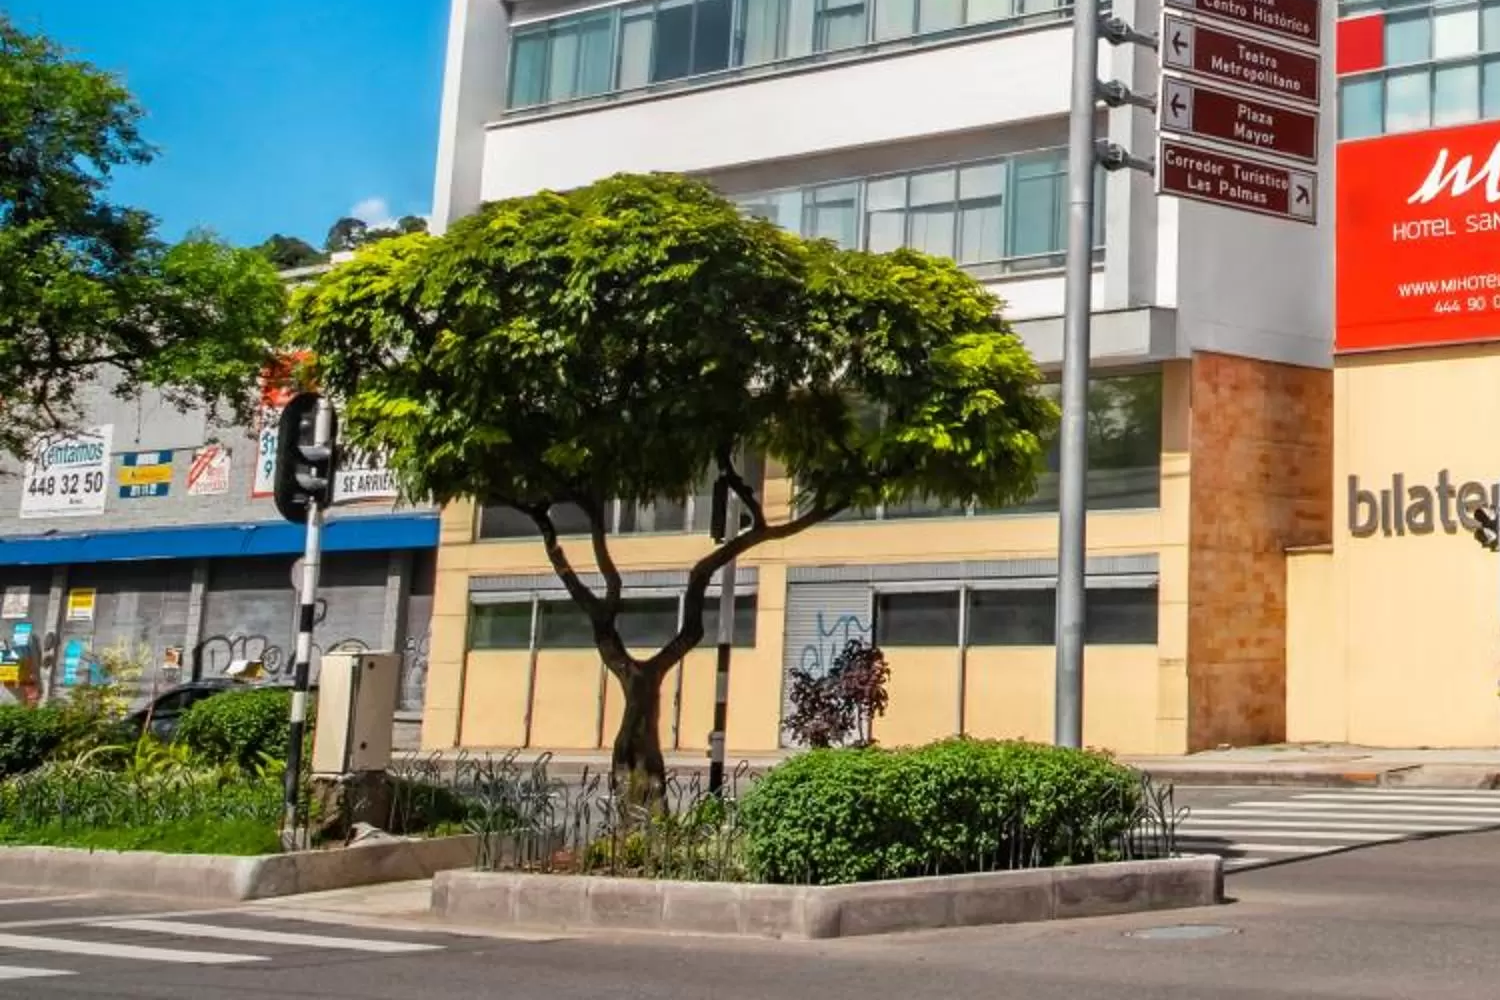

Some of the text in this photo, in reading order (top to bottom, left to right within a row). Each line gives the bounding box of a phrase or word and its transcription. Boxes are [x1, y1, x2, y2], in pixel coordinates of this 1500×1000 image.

[1237, 44, 1278, 69] Teatro
[1211, 55, 1301, 92] Metropolitano
[1237, 103, 1274, 127] Plaza
[1233, 121, 1275, 145] Mayor
[1165, 149, 1224, 177] Corredor
[1187, 172, 1268, 205] Las Palmas
[1433, 298, 1460, 314] 444
[1467, 296, 1486, 312] 90
[28, 475, 55, 497] 448
[60, 473, 81, 496] 32
[84, 470, 104, 494] 50
